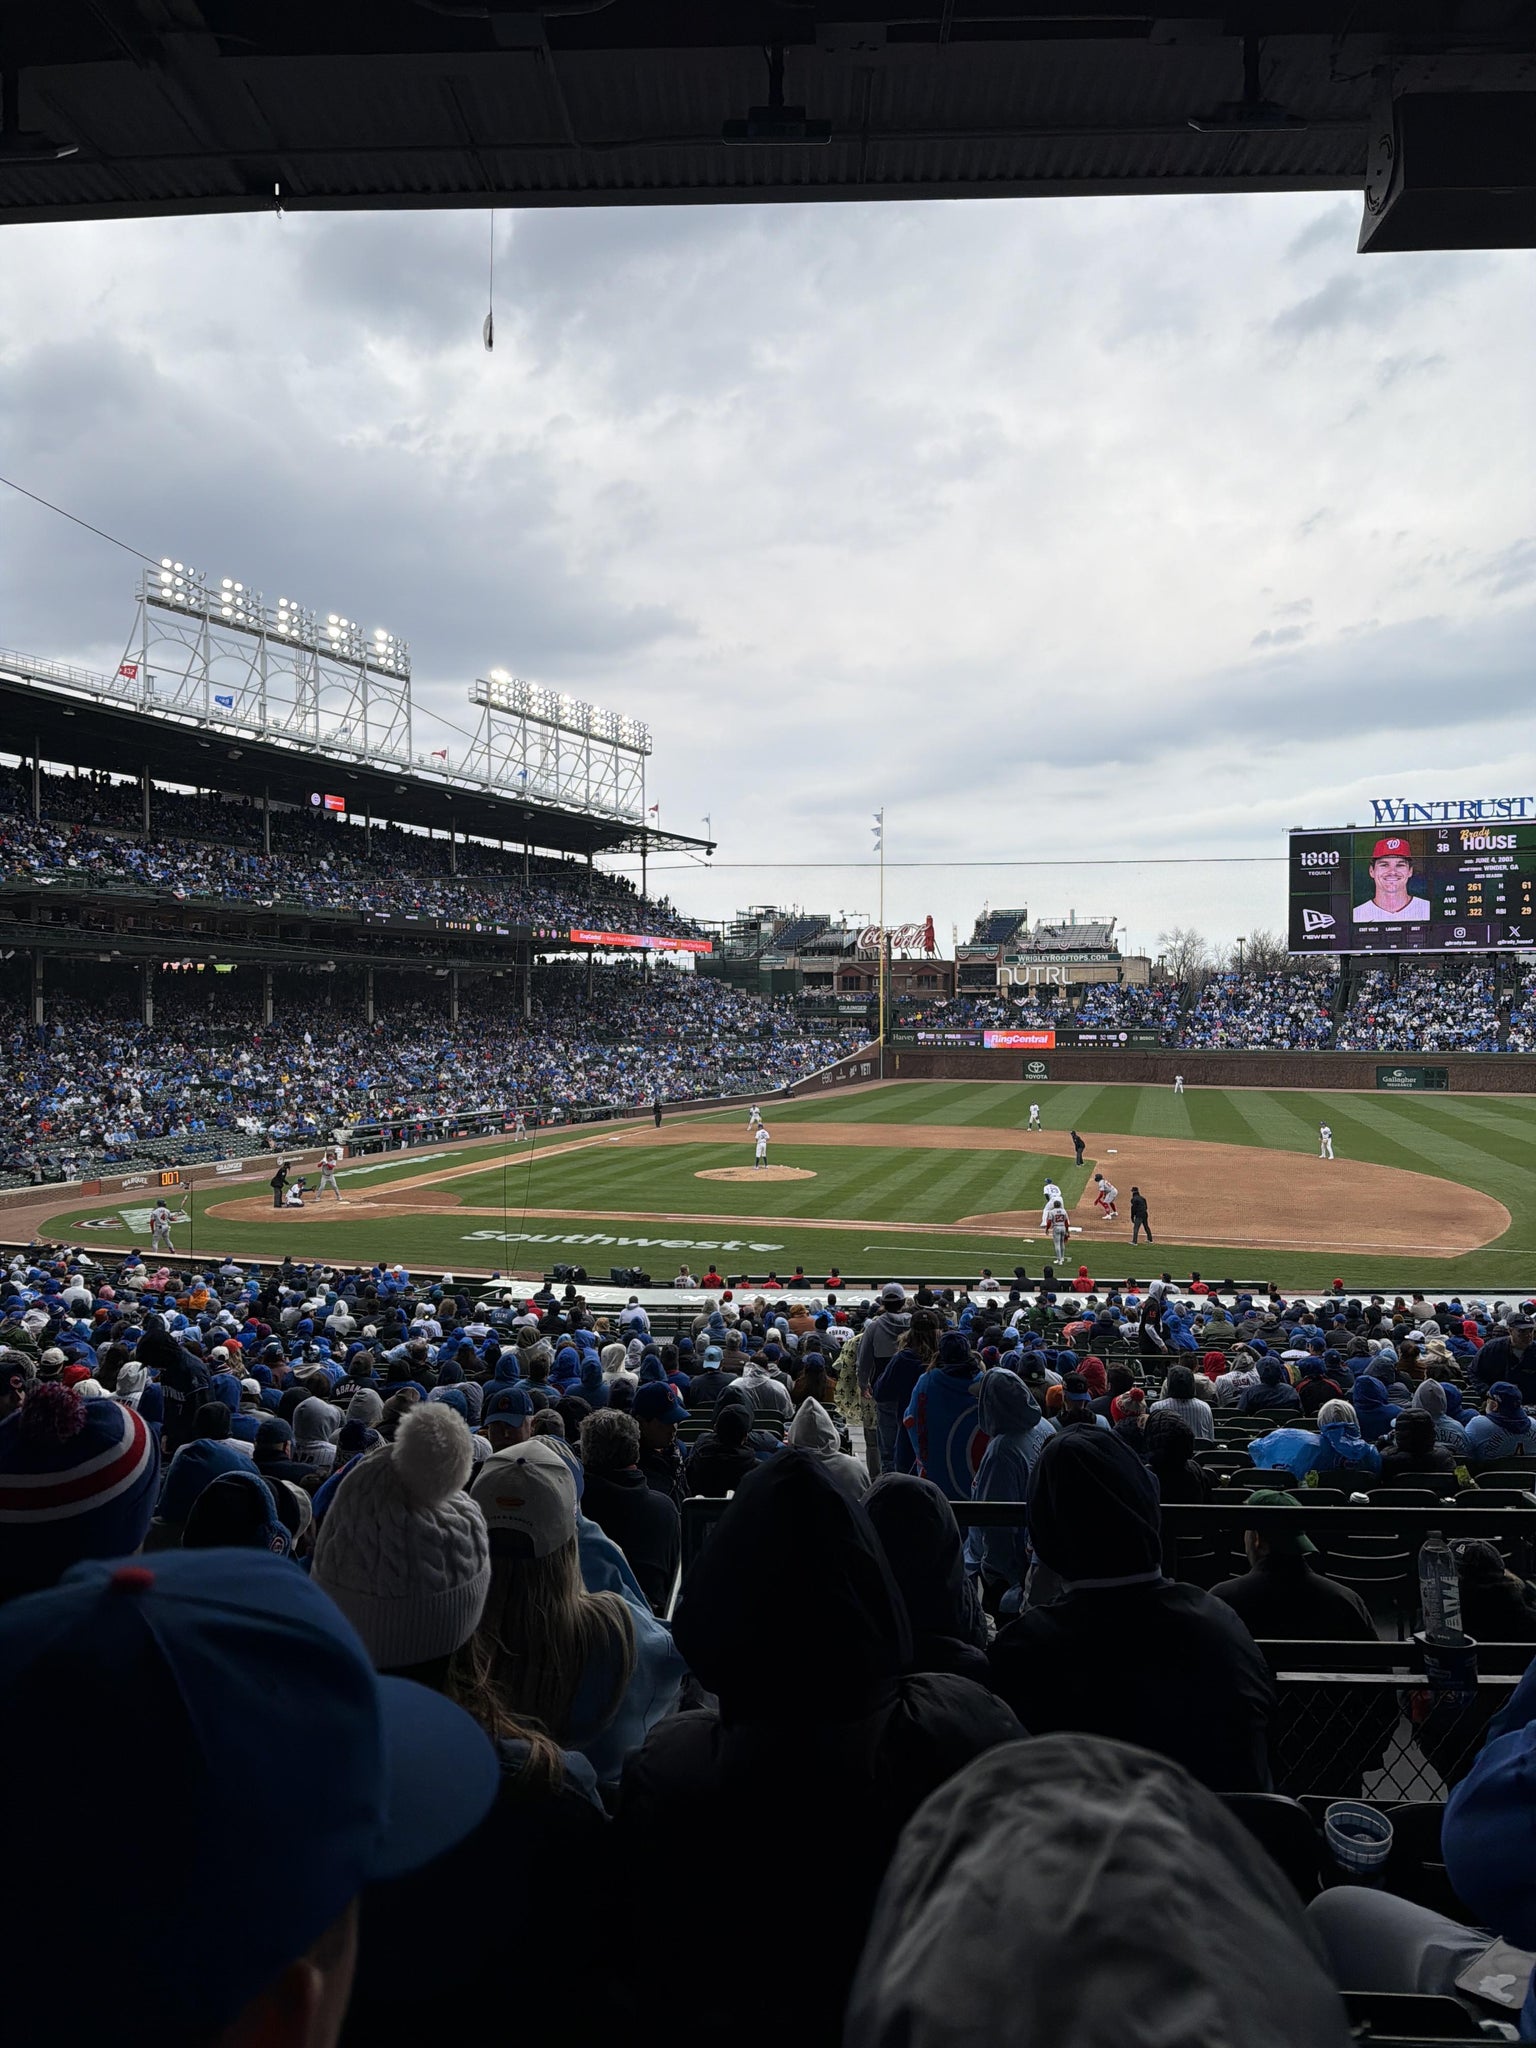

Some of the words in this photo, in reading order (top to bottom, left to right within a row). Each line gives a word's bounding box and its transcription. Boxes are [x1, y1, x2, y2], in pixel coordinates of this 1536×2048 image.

[1370, 797, 1534, 823] WINTRUST
[1438, 829, 1449, 839] 12
[1460, 826, 1491, 841] Brady
[1436, 843, 1450, 853] 3B
[1463, 834, 1518, 851] HOUSE
[1300, 850, 1340, 867] 1800
[1467, 883, 1482, 891] 261
[1521, 881, 1532, 890] 61
[1523, 894, 1530, 902] 4
[1521, 906, 1532, 915] 29
[892, 1034, 915, 1042] Harvey
[990, 1034, 1049, 1045] RingCentral
[860, 1062, 871, 1077] YETI
[121, 1176, 149, 1187] MARQUEE
[160, 1213, 166, 1221] 4
[1054, 1214, 1066, 1223] 23
[460, 1230, 748, 1251] Southwest
[335, 1383, 362, 1397] ABRAM
